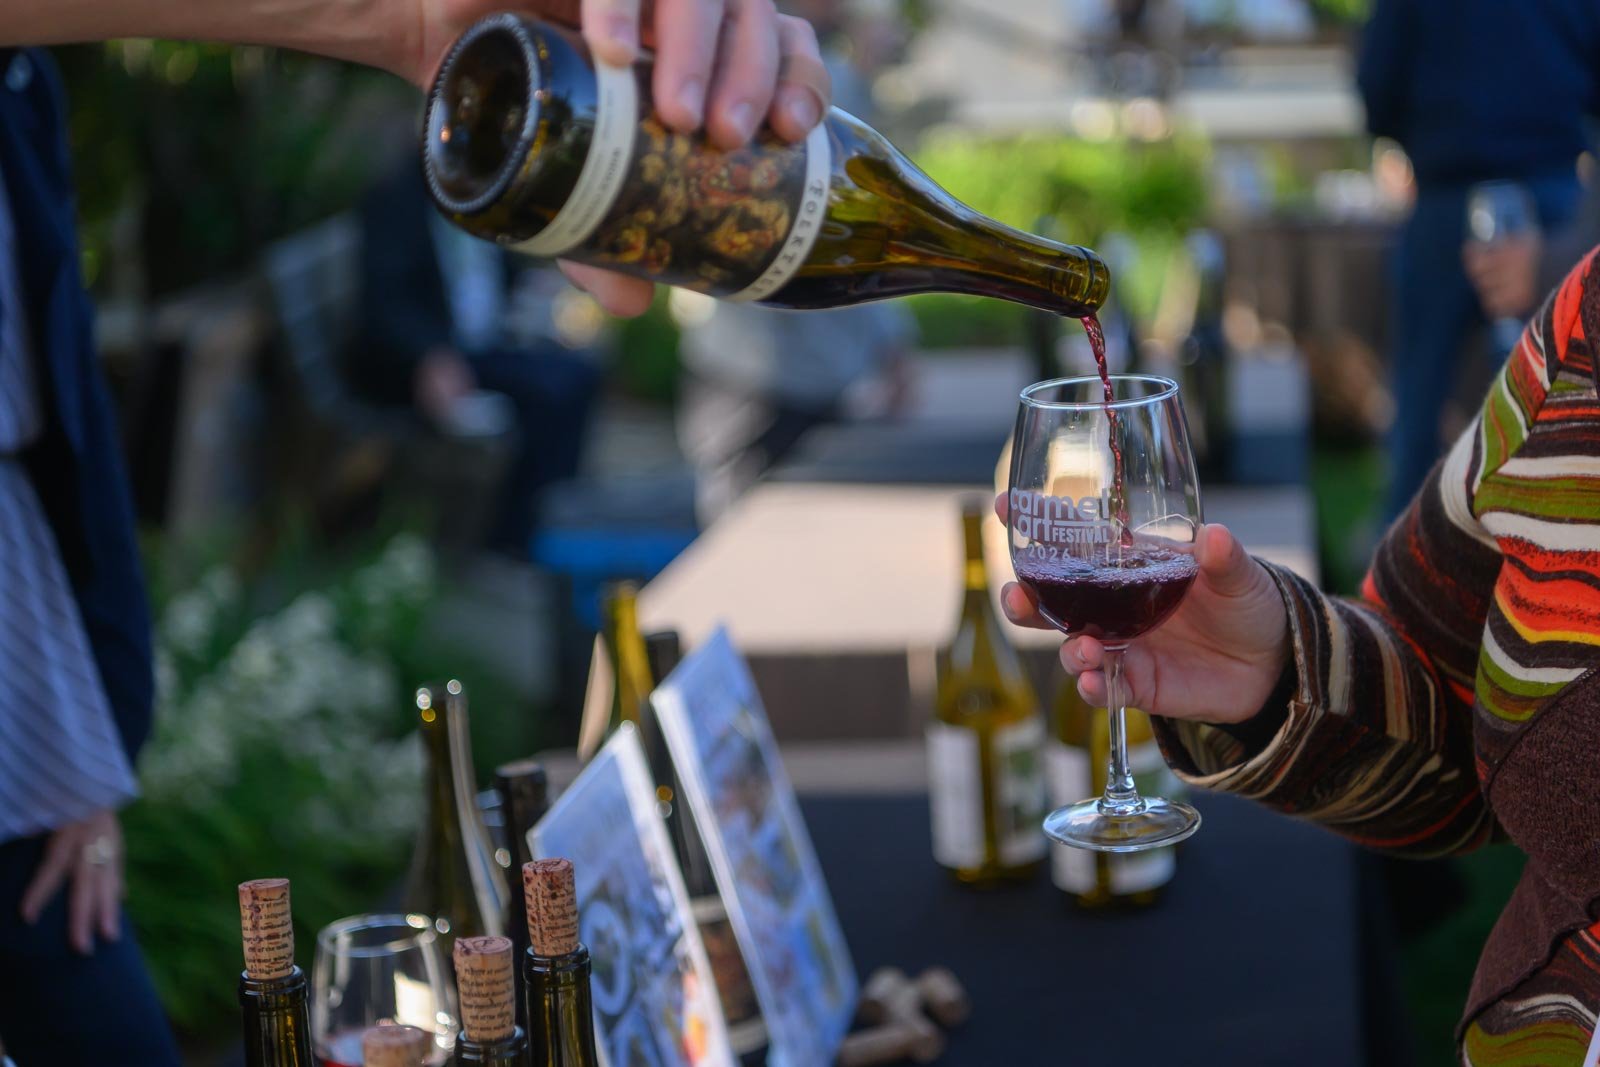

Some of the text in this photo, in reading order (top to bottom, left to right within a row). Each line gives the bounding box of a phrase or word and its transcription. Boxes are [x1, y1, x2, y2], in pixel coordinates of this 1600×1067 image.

[1010, 487, 1110, 520] carmel
[1017, 515, 1110, 543] art FESTIVAL
